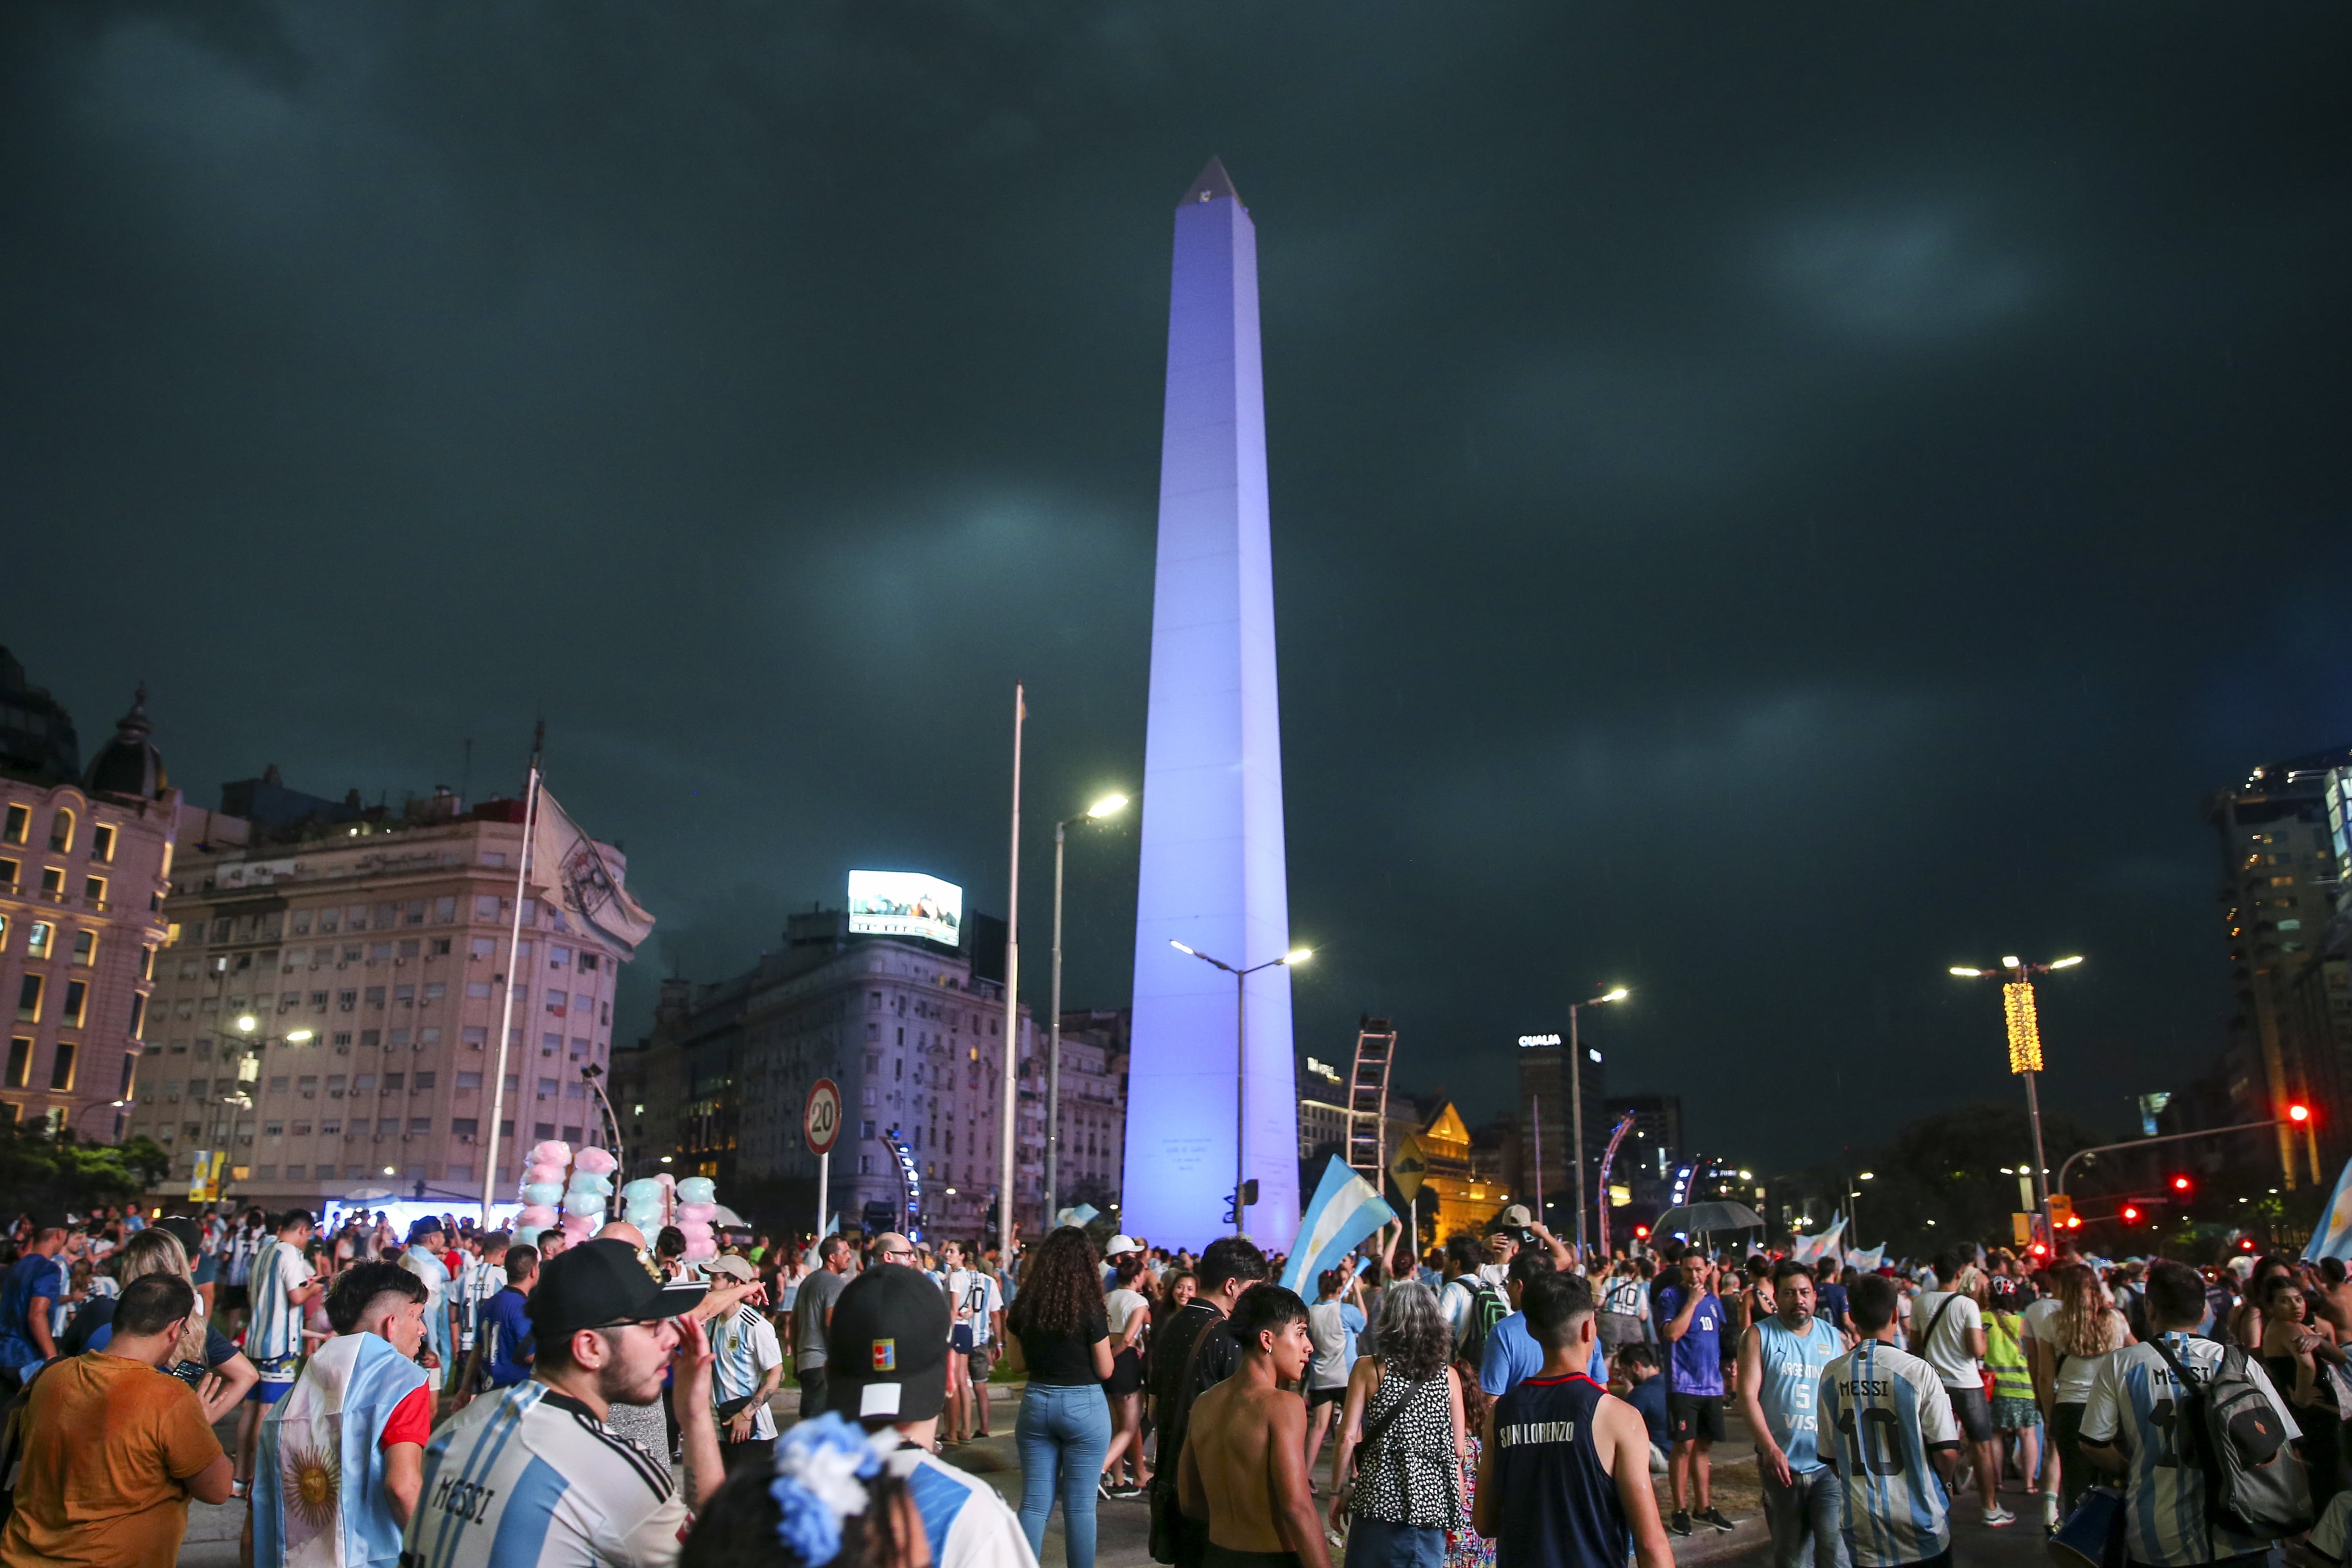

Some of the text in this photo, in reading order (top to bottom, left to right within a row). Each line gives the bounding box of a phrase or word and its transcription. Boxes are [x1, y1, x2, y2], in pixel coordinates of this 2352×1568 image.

[1519, 1034, 1561, 1047] QUALIA
[812, 1100, 833, 1132] 20
[468, 1283, 489, 1291] MESSI
[1699, 1316, 1714, 1331] 10
[2153, 1366, 2210, 1385] MESI
[1796, 1383, 1810, 1409] 5
[1839, 1379, 1888, 1397] MESSI
[1781, 1413, 1818, 1432] VIS
[1500, 1421, 1575, 1448] SAN LORENZO
[1837, 1408, 1905, 1476] 10
[433, 1475, 495, 1525] MESSI
